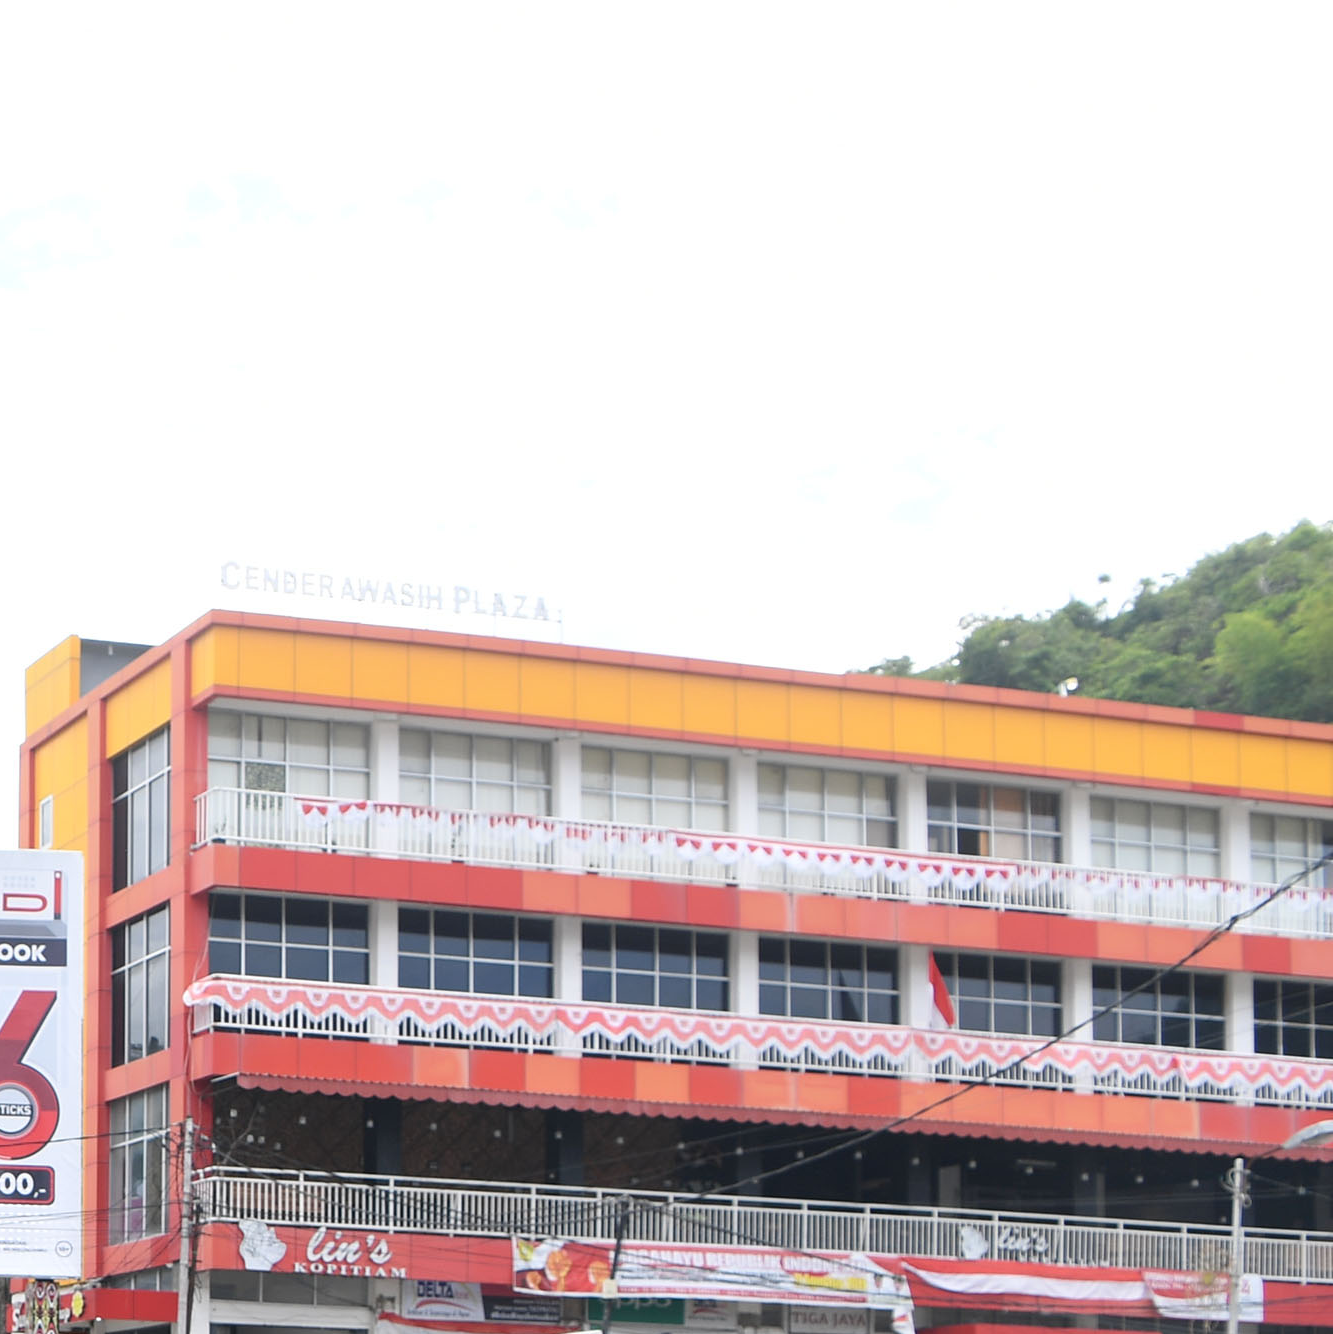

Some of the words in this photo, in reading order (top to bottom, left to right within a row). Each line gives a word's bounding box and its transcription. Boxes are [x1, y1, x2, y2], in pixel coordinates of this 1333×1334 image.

[221, 561, 442, 610] CENDERAWASIH
[453, 586, 549, 621] PLAZA
[306, 1226, 393, 1264] lin's
[294, 1262, 407, 1279] KOPITIAM
[417, 1280, 454, 1299] DELTA
[793, 1311, 829, 1325] TIGA
[833, 1313, 867, 1328] JAYA
